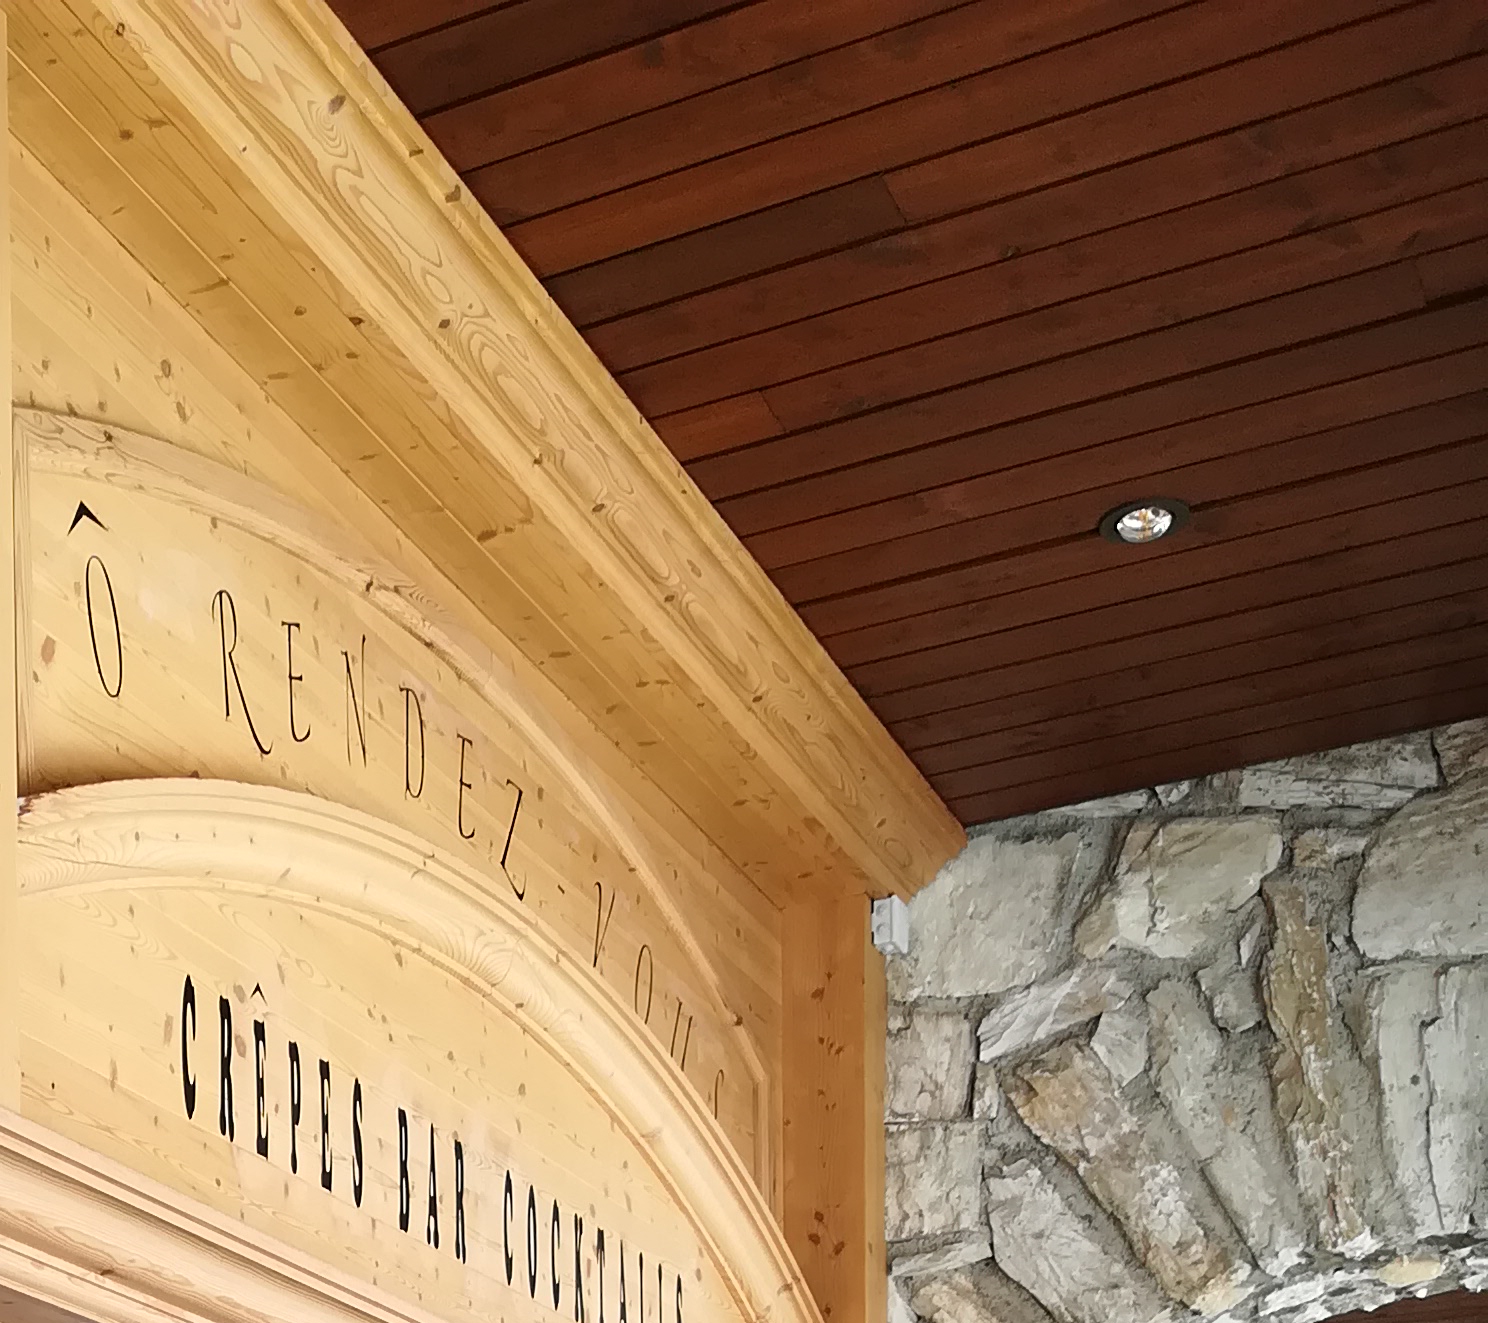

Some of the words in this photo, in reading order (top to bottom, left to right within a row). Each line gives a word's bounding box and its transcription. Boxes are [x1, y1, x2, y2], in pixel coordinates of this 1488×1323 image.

[67, 500, 123, 698] Ô
[181, 974, 363, 1209] CRÊPES
[397, 1106, 467, 1265] BAR
